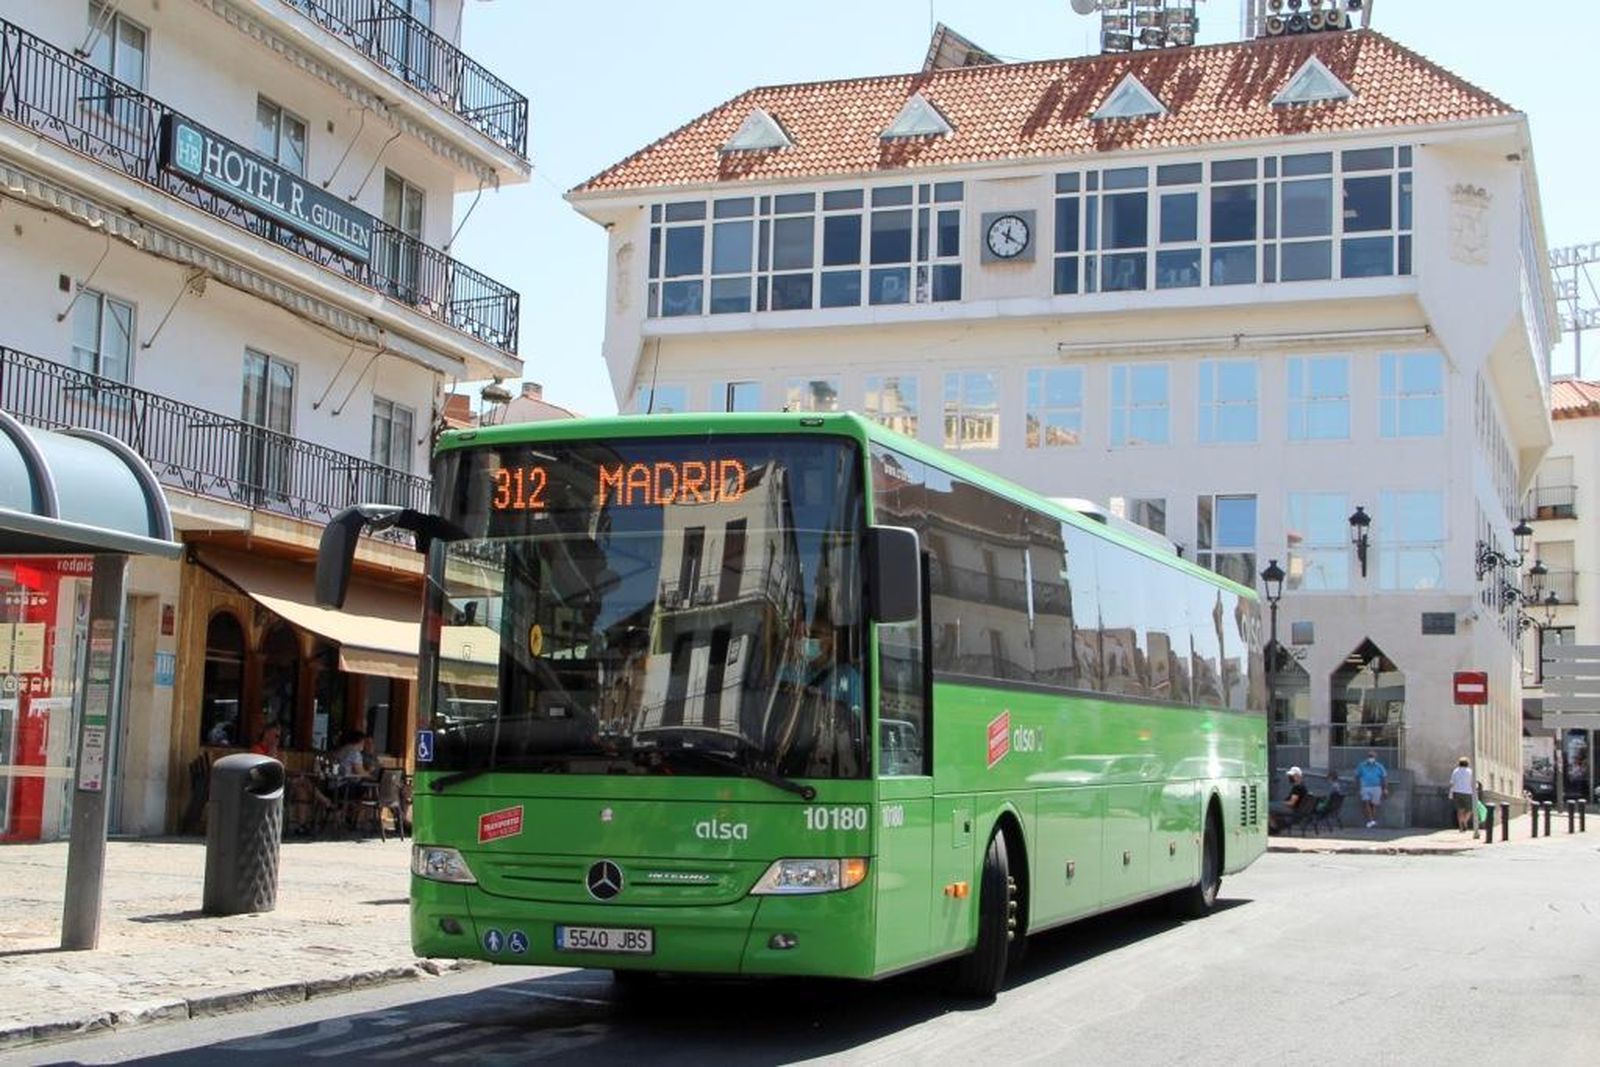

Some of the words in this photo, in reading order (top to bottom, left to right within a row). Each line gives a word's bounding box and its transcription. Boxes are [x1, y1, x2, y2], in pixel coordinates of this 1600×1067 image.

[204, 137, 285, 208] HOTEL
[290, 181, 309, 221] R.
[312, 203, 370, 249] GUILLEN
[493, 467, 547, 509] 312
[599, 459, 746, 506] MADRID
[695, 819, 748, 840] alsa
[803, 807, 867, 831] 10180
[569, 929, 609, 949] 5540
[617, 931, 648, 950] JBS
